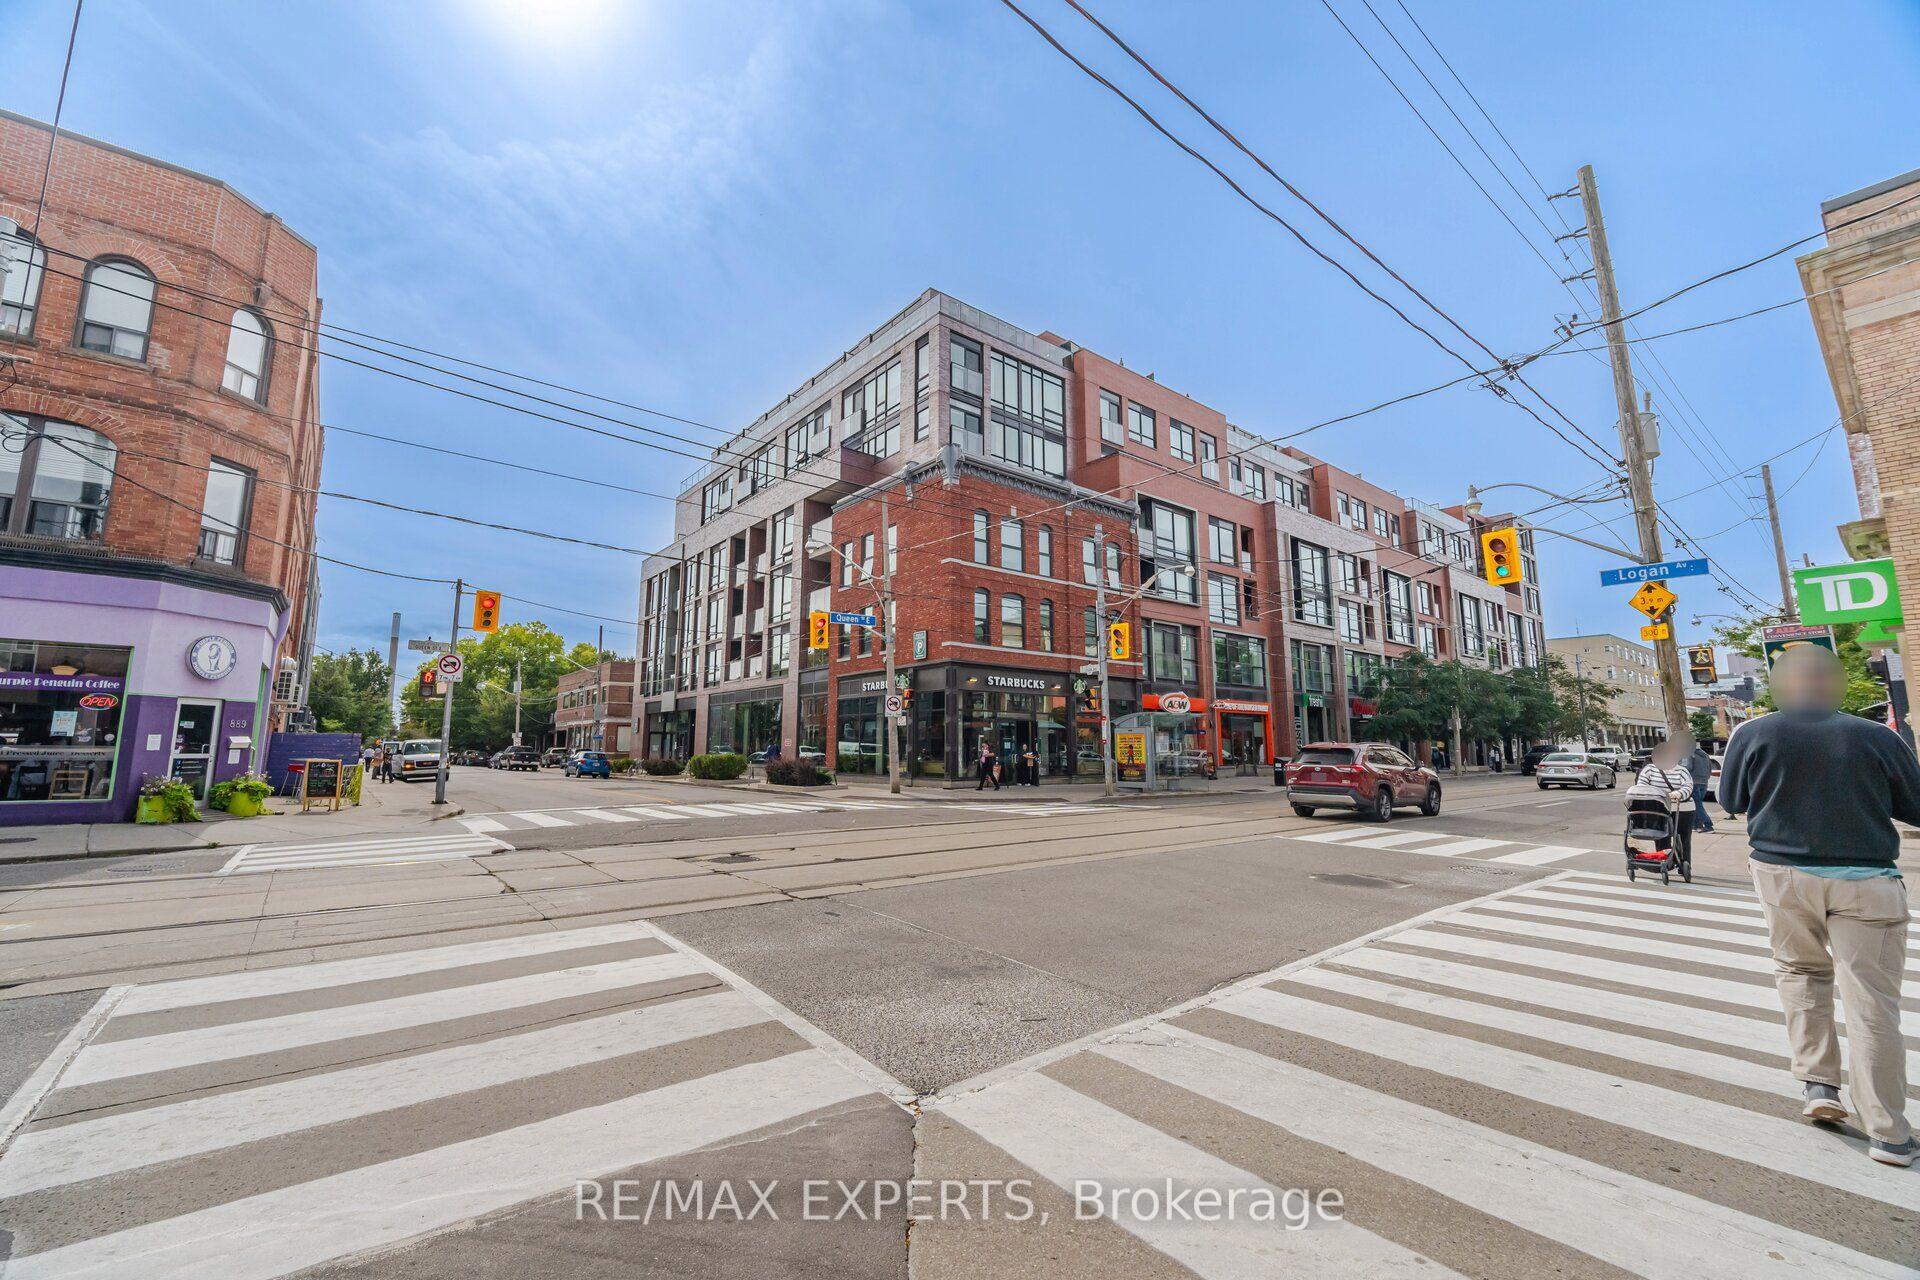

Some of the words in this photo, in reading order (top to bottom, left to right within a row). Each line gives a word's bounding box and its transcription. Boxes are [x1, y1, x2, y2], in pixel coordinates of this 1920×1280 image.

[1617, 566, 1670, 581] Logan
[1804, 571, 1889, 612] TD
[836, 614, 859, 623] Queen
[34, 678, 83, 688] Penguin
[85, 680, 120, 689] Coffee
[987, 675, 1046, 690] STARBUCKS
[81, 697, 115, 706] OPEN
[1167, 700, 1188, 710] A&W
[229, 719, 247, 729] 889
